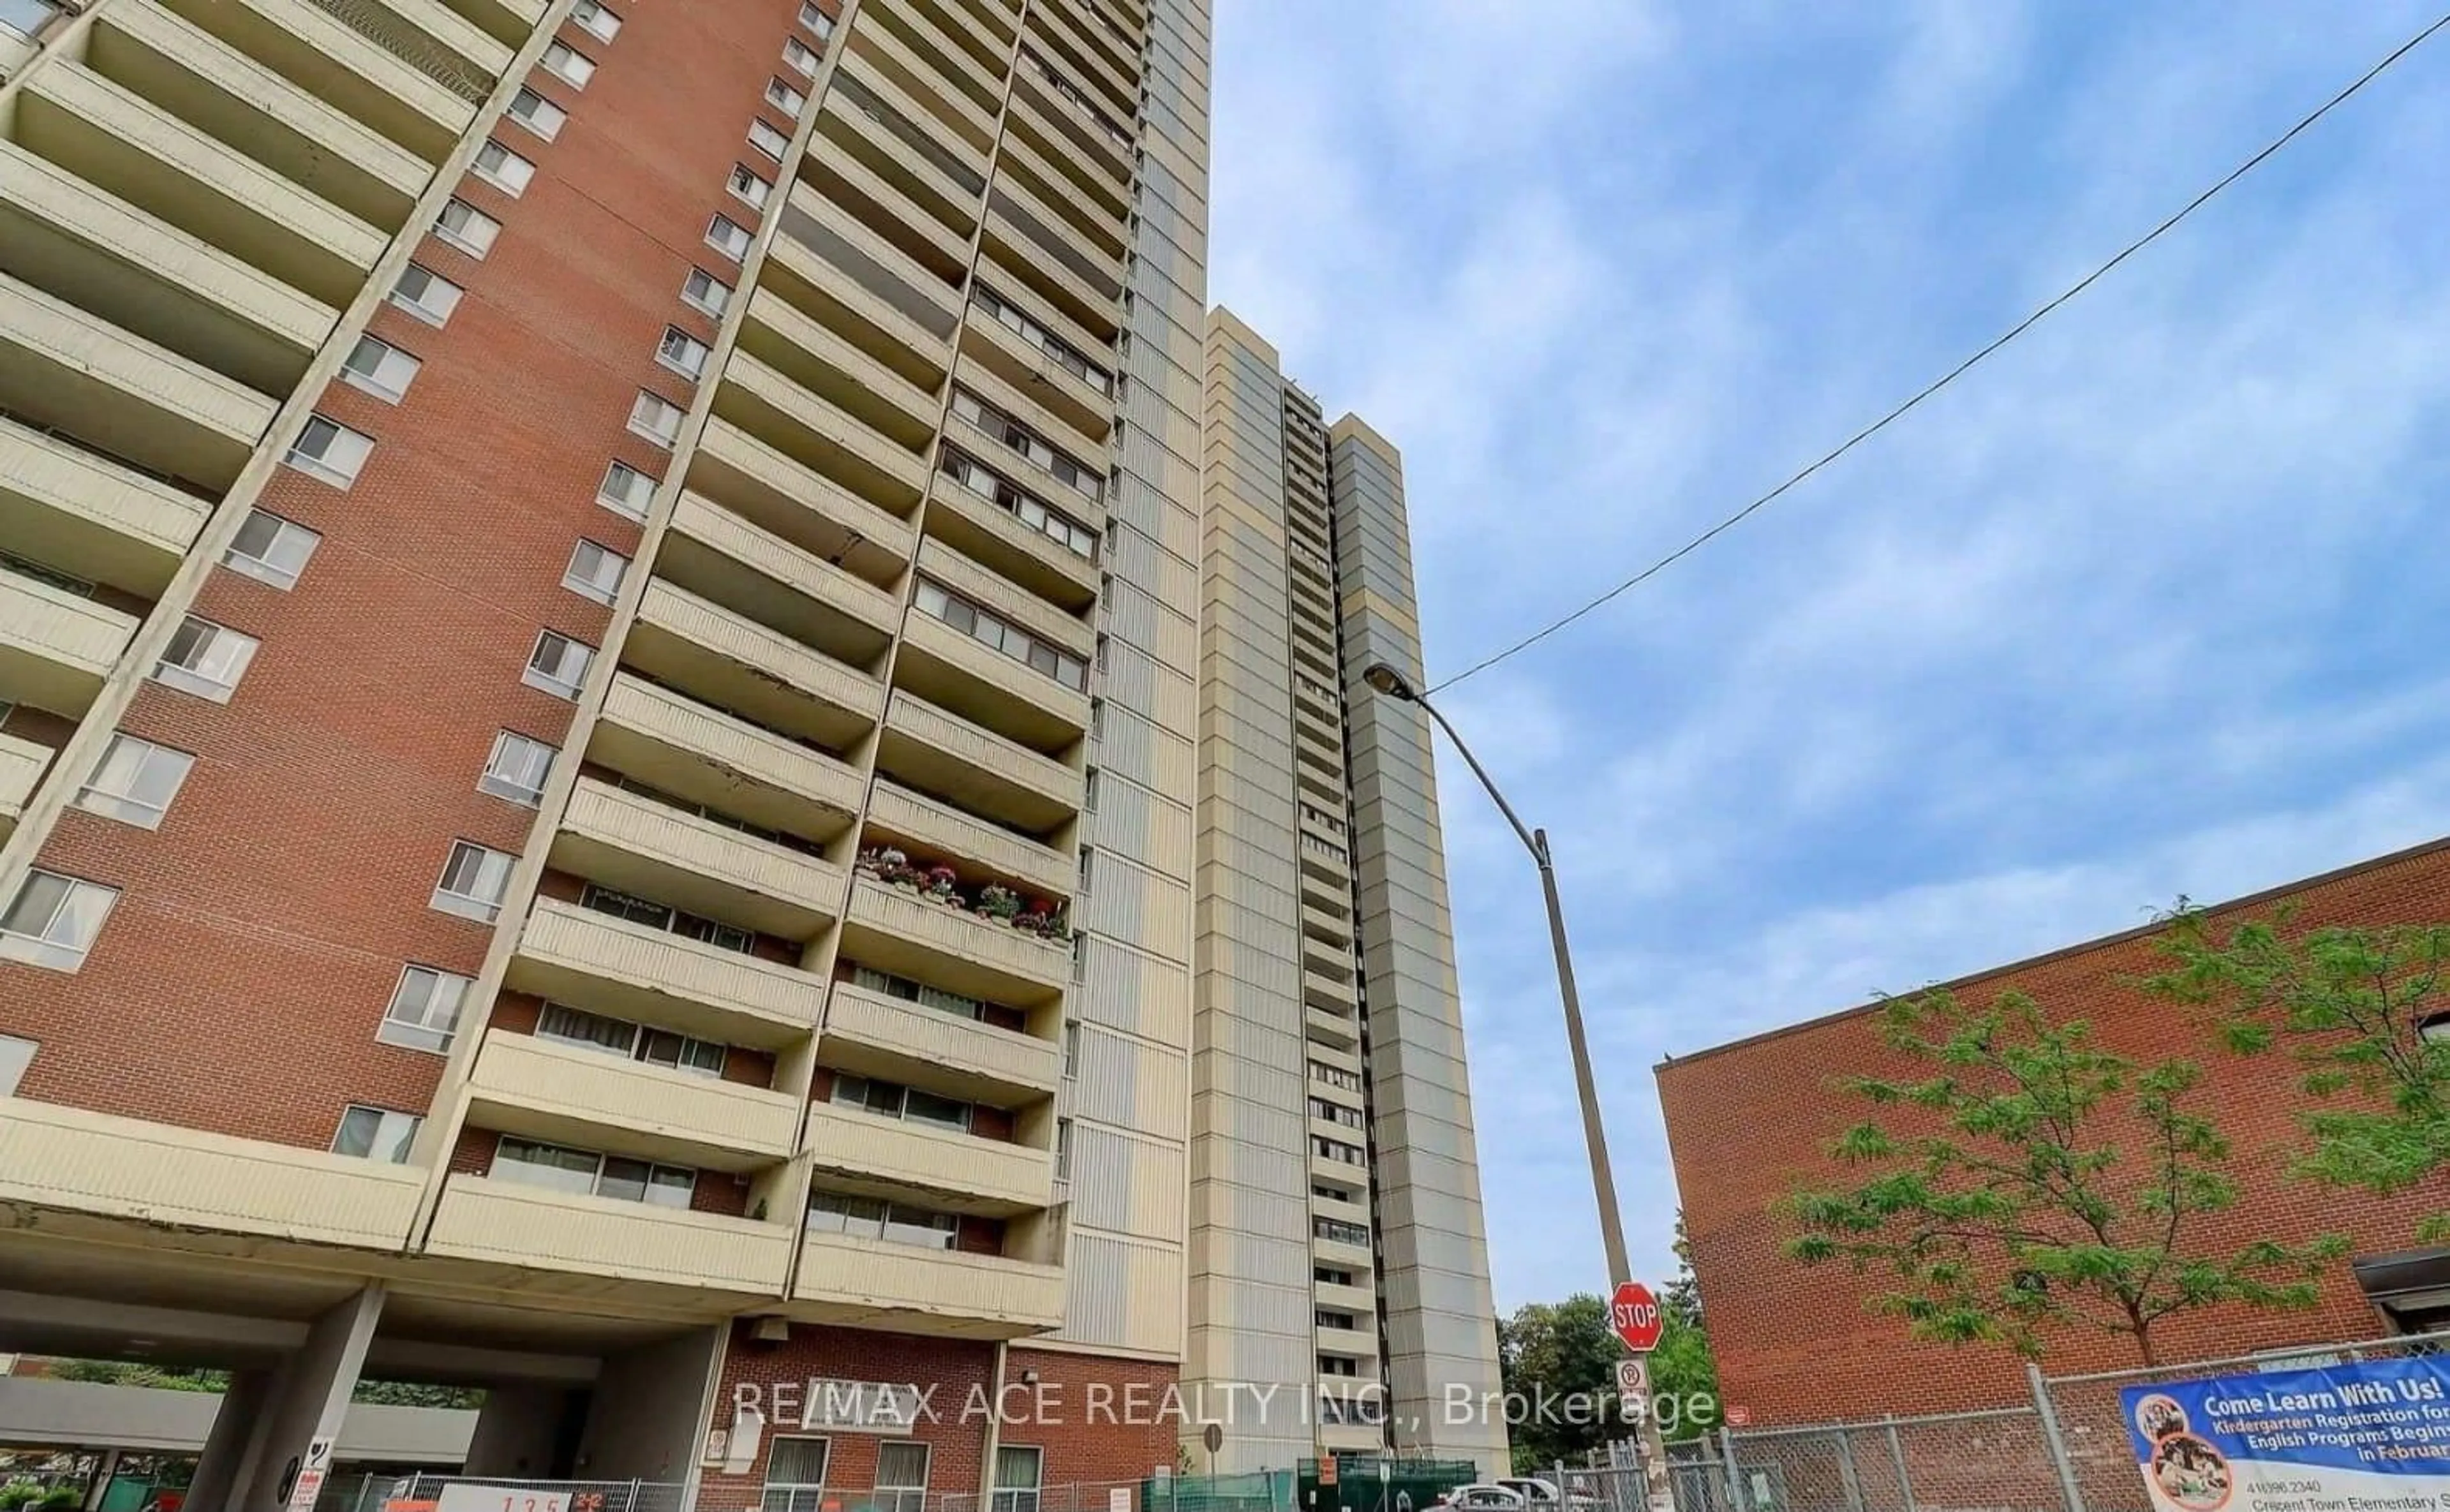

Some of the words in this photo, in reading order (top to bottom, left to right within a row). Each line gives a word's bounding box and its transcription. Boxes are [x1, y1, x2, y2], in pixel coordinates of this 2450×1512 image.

[1615, 1303, 1656, 1329] STOP
[2205, 1396, 2264, 1416] Come
[2266, 1392, 2337, 1412] Learn
[2337, 1381, 2396, 1407] With
[2396, 1377, 2444, 1402] Us!
[2212, 1417, 2313, 1435] Kindergarten
[2314, 1408, 2420, 1430] Registration
[2421, 1404, 2450, 1421] for
[2247, 1432, 2306, 1451] English
[2307, 1430, 2389, 1448] Programs
[2356, 1446, 2376, 1462] in
[2306, 1497, 2346, 1512] Town
[2347, 1496, 2437, 1512] Elementary
